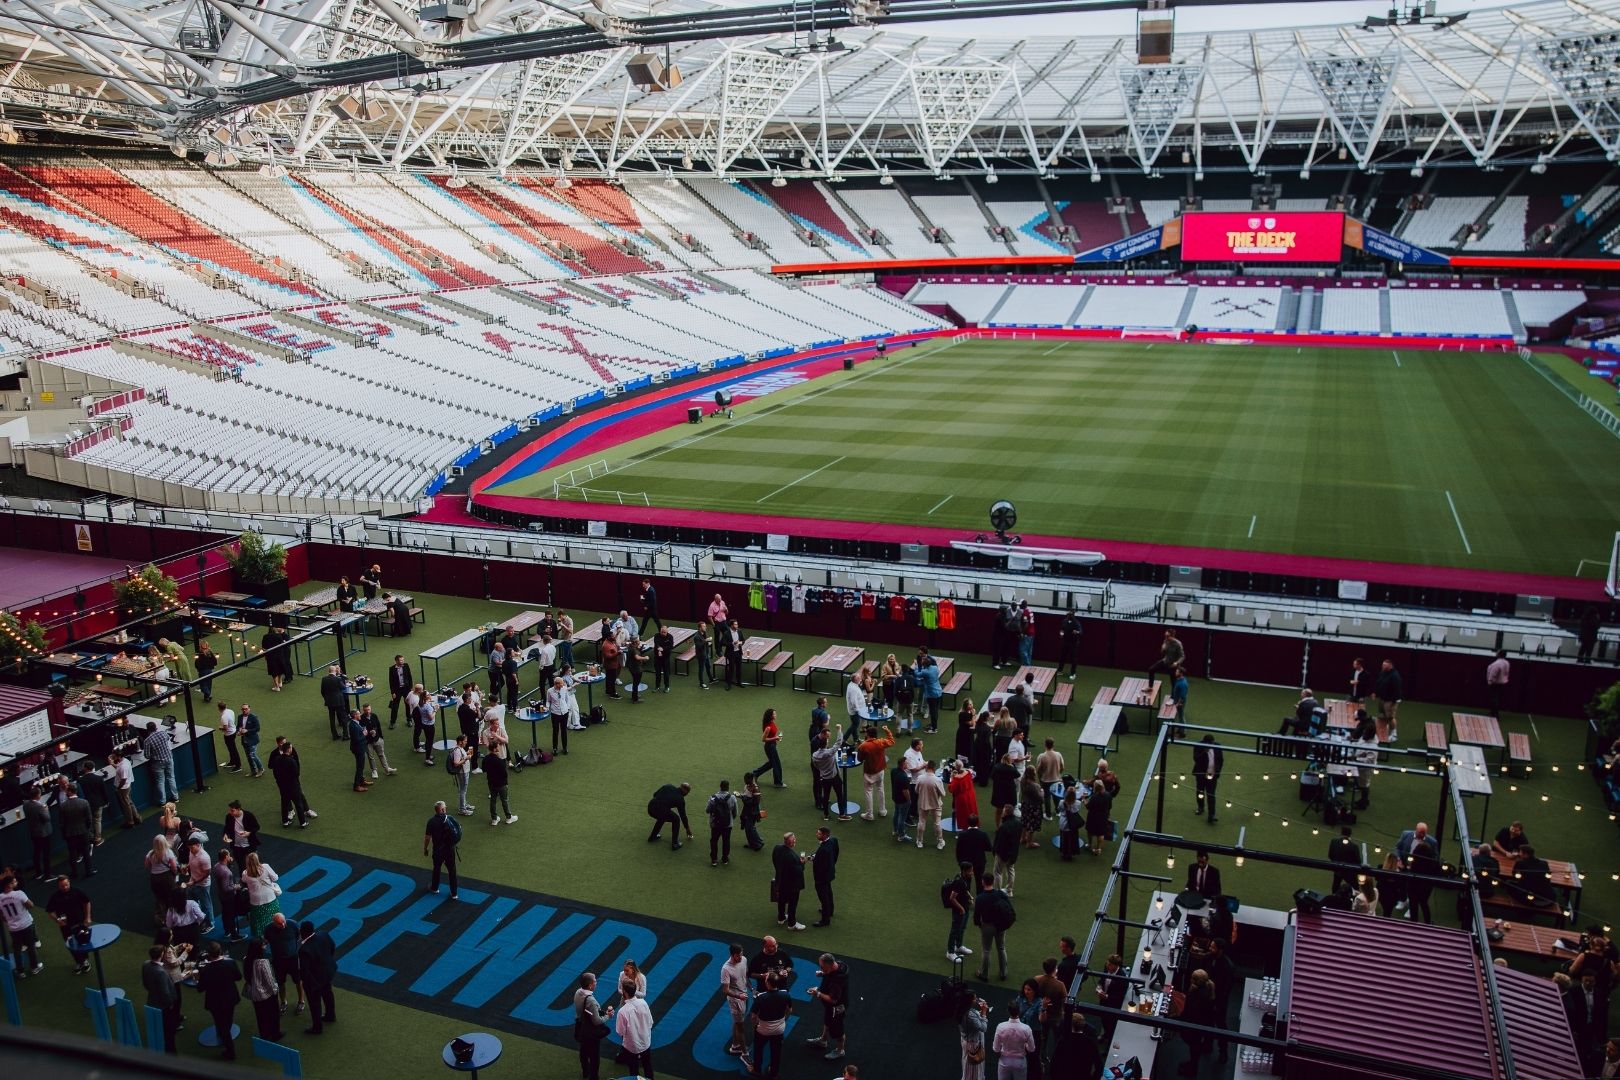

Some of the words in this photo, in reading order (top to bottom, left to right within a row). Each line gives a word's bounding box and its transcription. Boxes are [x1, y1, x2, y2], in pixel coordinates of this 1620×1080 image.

[1226, 231, 1256, 248] THE
[1256, 231, 1296, 248] DECK
[843, 598, 854, 609] 25
[3, 902, 18, 917] 11
